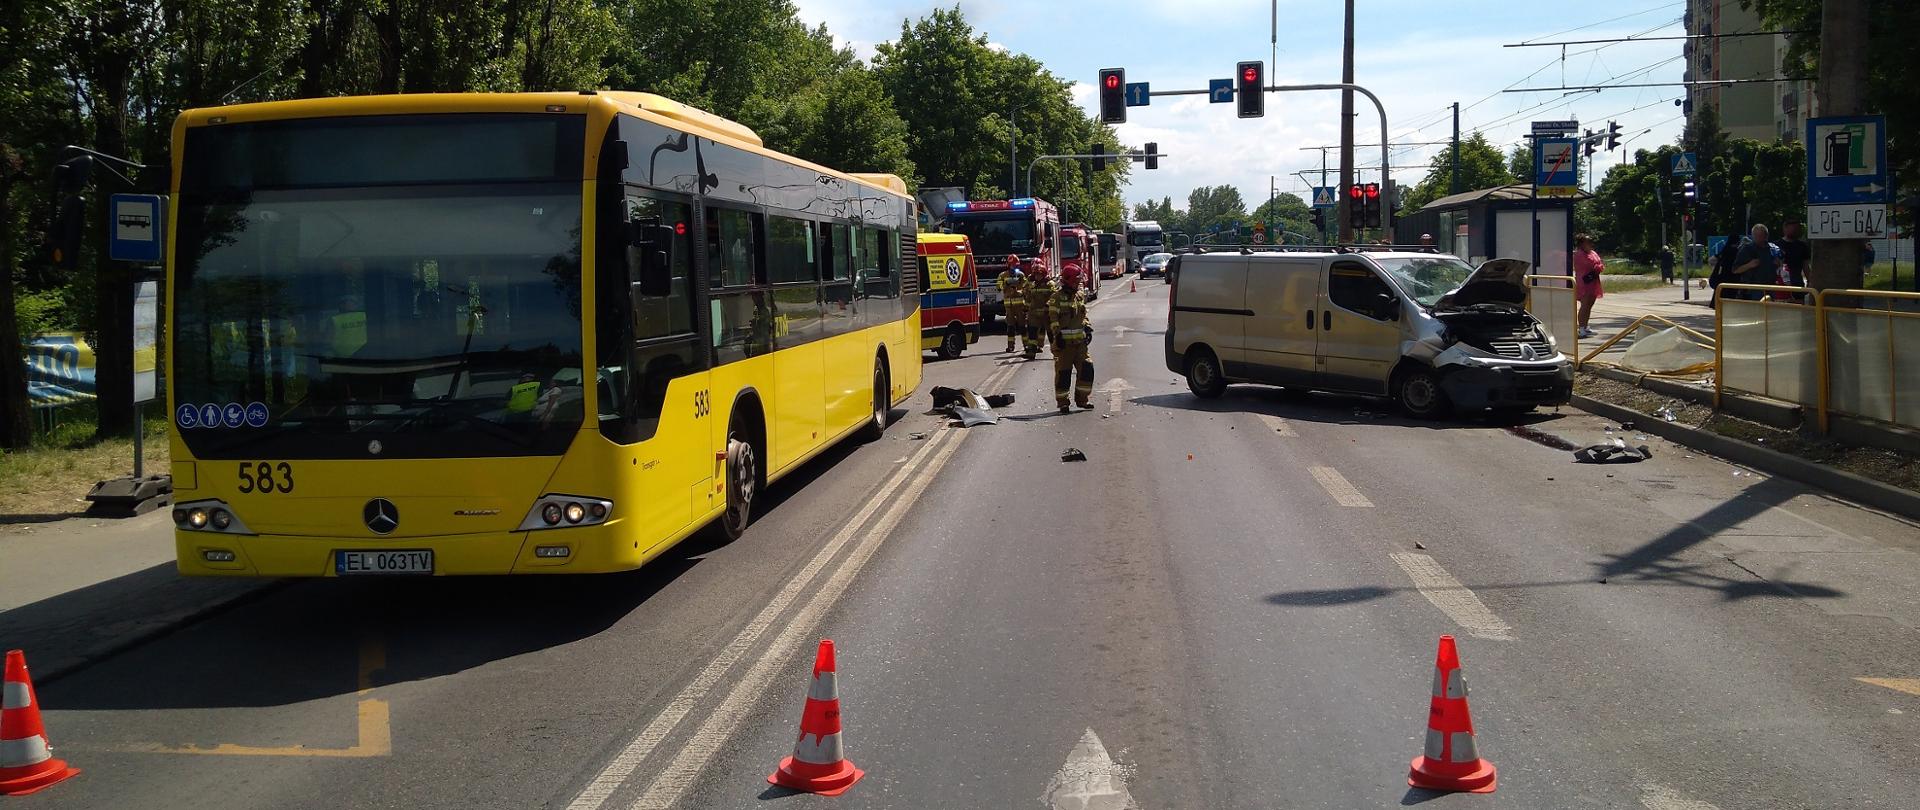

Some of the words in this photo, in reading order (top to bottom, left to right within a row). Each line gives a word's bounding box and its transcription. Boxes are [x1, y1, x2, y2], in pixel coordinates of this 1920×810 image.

[694, 389, 709, 419] 583
[238, 461, 294, 493] 583
[347, 553, 371, 570] EL
[377, 553, 429, 570] 063TV
